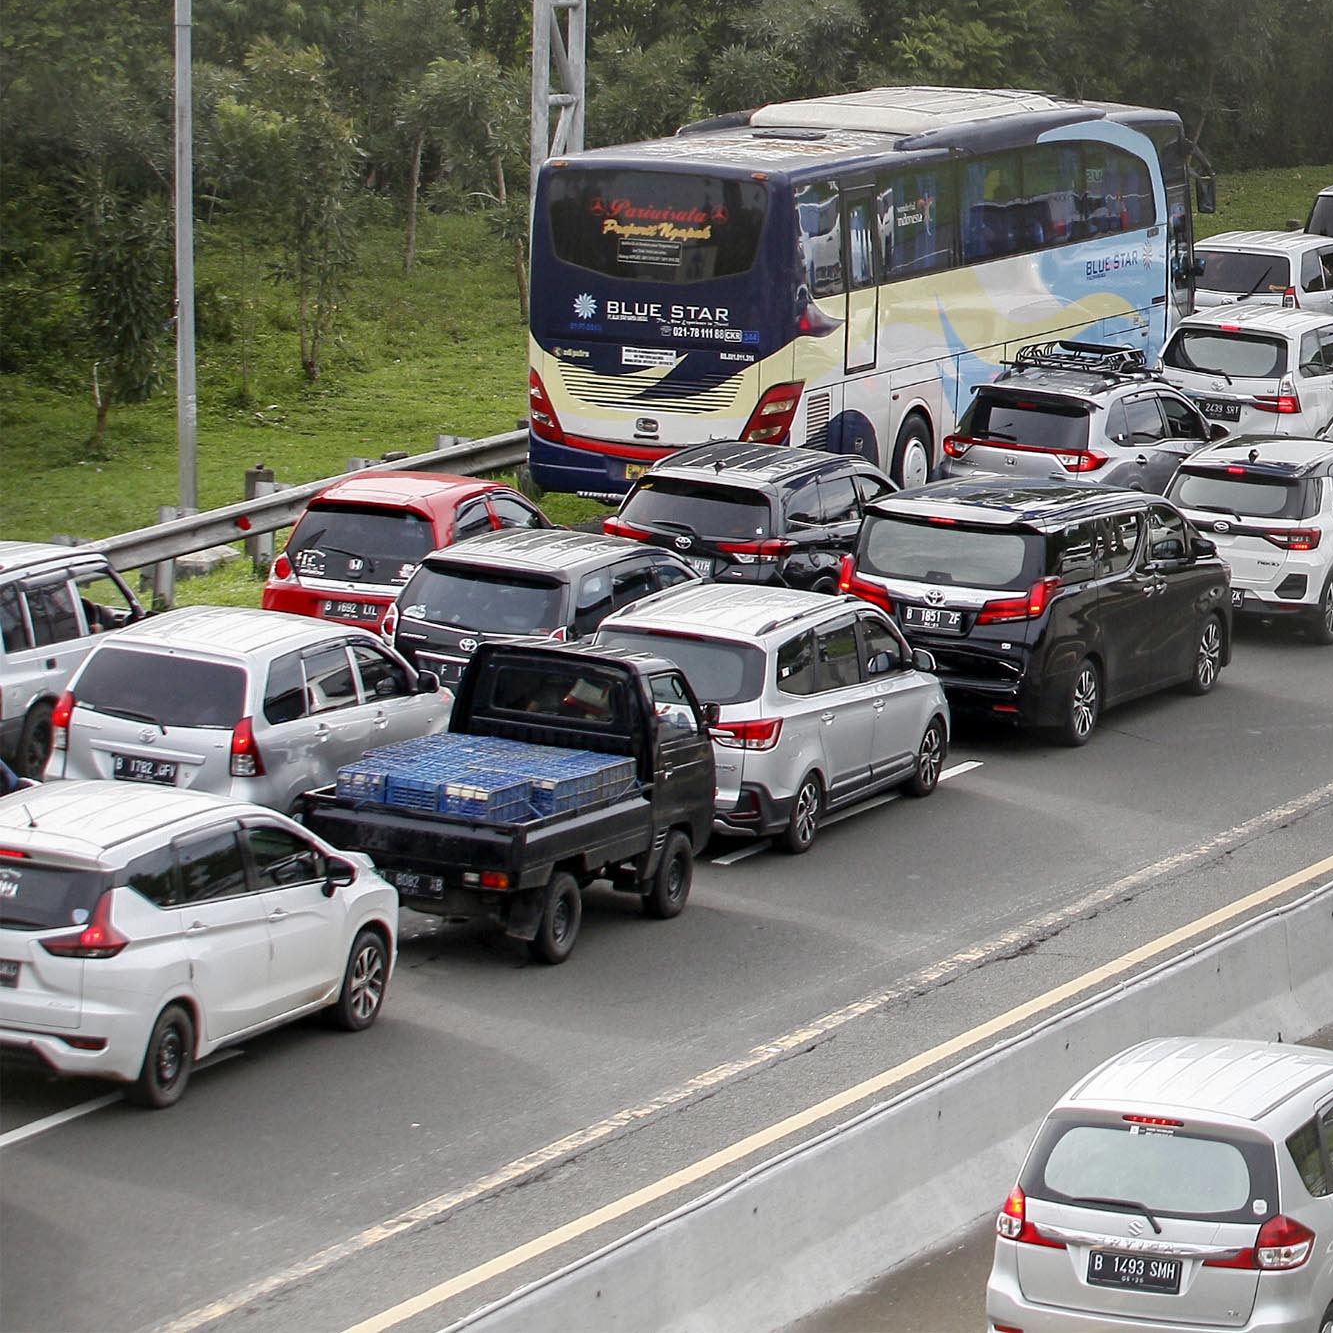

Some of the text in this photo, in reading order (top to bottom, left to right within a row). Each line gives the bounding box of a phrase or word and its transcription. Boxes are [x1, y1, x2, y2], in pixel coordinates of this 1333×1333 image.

[1086, 257, 1110, 276] BLUE
[1113, 250, 1138, 269] STAR
[606, 301, 729, 322] BLUE STAR
[673, 326, 699, 338] 021-78
[700, 329, 713, 339] 111
[1205, 403, 1223, 413] 2439
[325, 601, 332, 611] B
[906, 608, 960, 624] B 1851 ZF
[441, 664, 447, 675] F
[116, 757, 122, 770] B
[130, 760, 153, 773] 1782
[1095, 1258, 1175, 1279] B 1493 SMH
